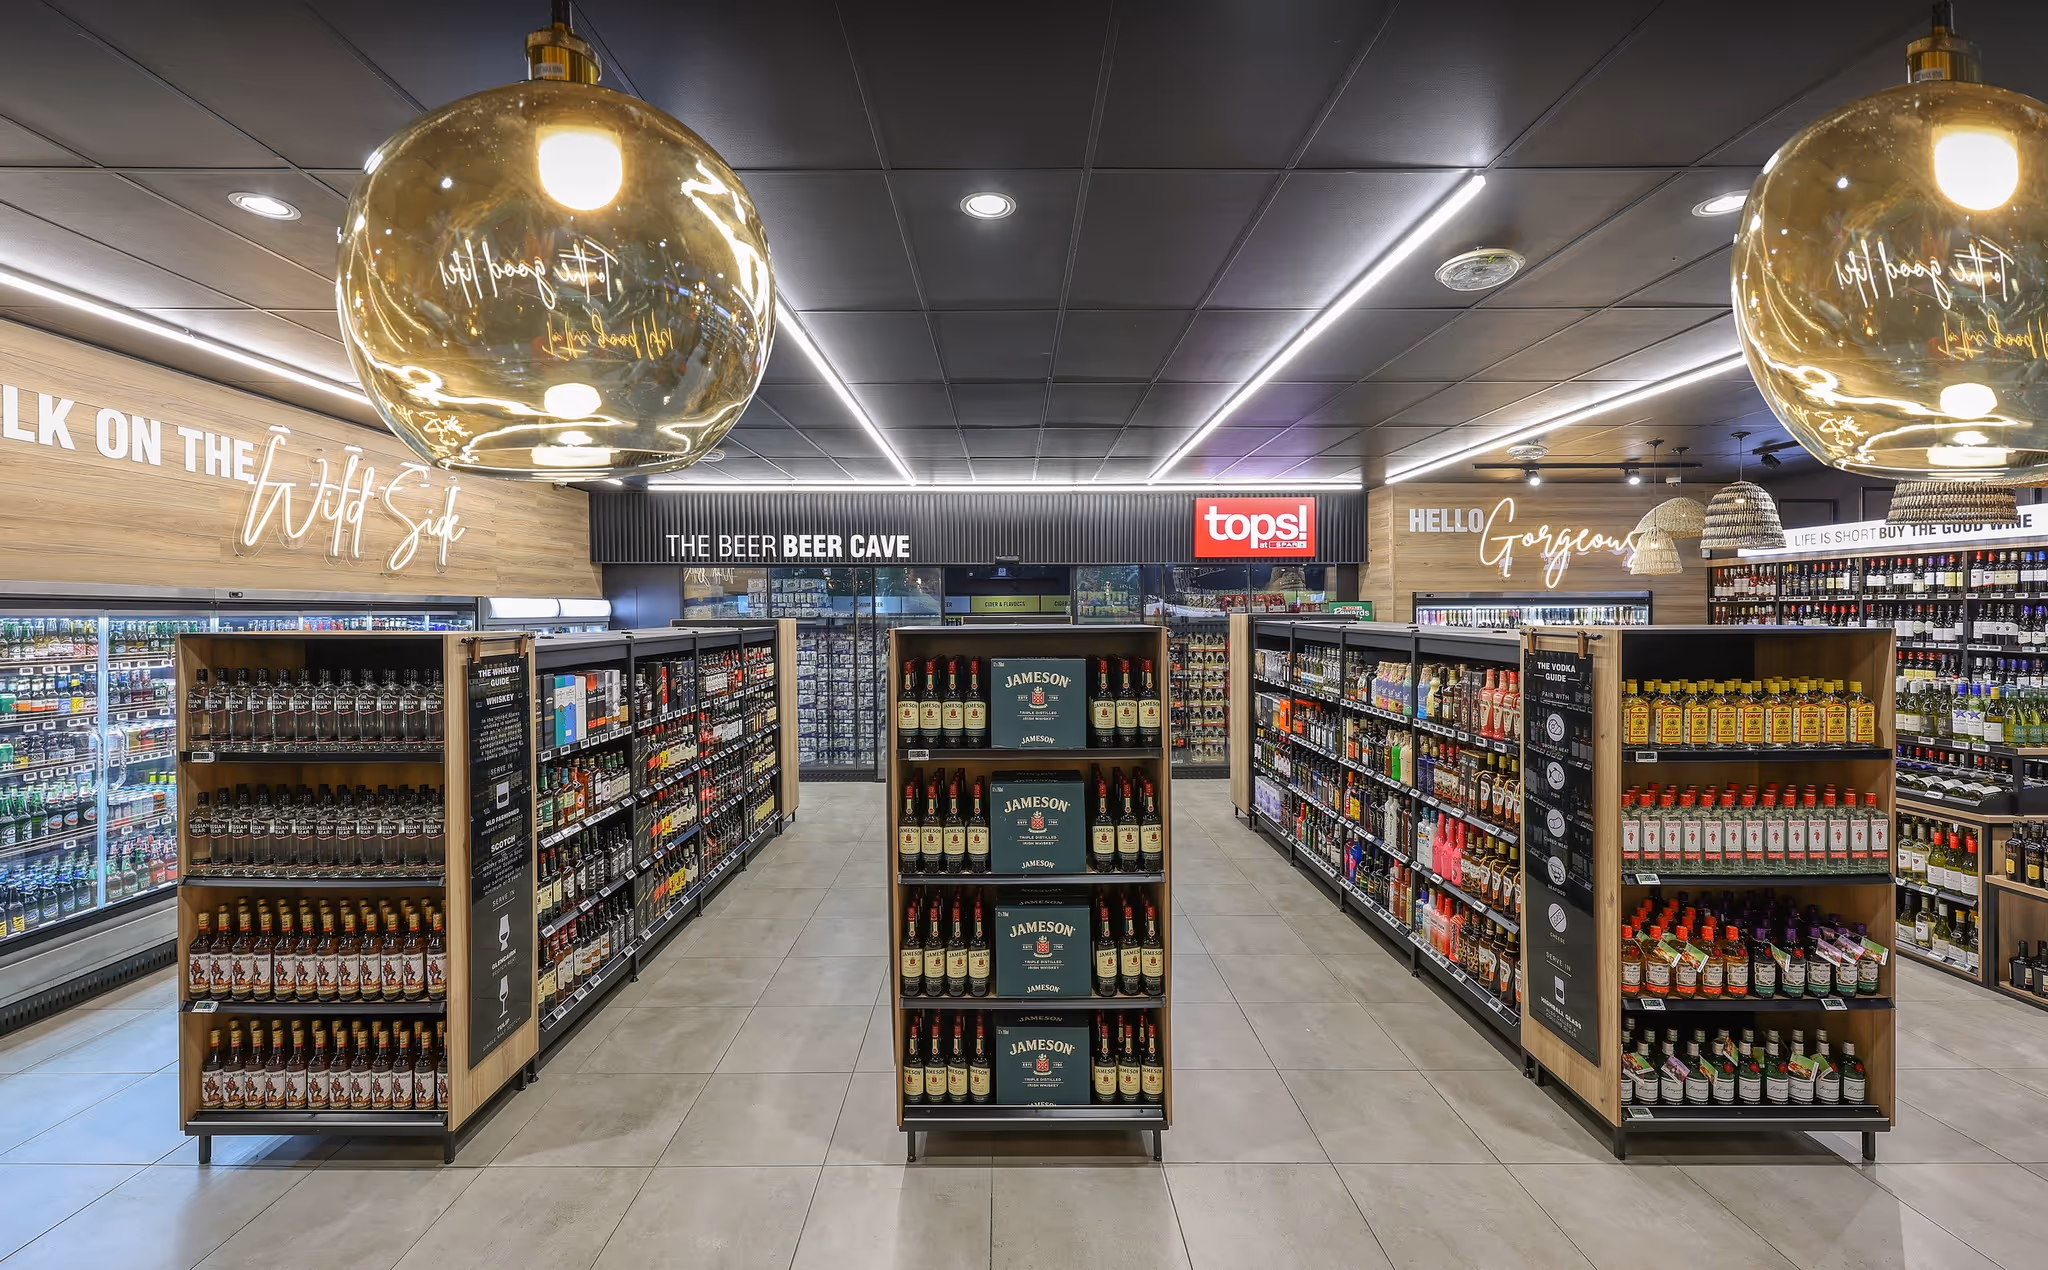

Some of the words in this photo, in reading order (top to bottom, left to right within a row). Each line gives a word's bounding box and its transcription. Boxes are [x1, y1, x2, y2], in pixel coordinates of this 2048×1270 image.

[2, 384, 76, 451] LK
[96, 408, 162, 466] ON
[177, 425, 255, 483] THE
[242, 430, 374, 558] Wild
[381, 466, 467, 571] Side
[1204, 505, 1307, 549] tops!
[1409, 508, 1484, 533] HELLO
[1794, 533, 1816, 547] LIFE
[1820, 532, 1831, 544] IS
[1835, 527, 1877, 543] SHORT
[1879, 525, 1905, 540] BUY
[1909, 523, 1937, 537] THE
[1941, 522, 1984, 534] GOOD
[665, 534, 710, 557] THE
[718, 534, 777, 557] BEER
[783, 534, 843, 558] BEER
[850, 534, 910, 558] CAVE
[1259, 541, 1268, 549] at
[478, 668, 492, 678] THE
[492, 665, 520, 676] WHISKEY
[1537, 662, 1551, 670] THE
[1551, 663, 1576, 673] VODKA
[490, 677, 510, 687] GUIDE
[1005, 671, 1069, 689] JAMESON
[1545, 672, 1567, 683] GUIDE
[486, 693, 514, 706] WHISKEY
[1541, 690, 1554, 698] PAIR
[1555, 693, 1570, 701] WITH
[1020, 735, 1056, 745] JAMESON
[490, 765, 506, 776] SERVE
[1004, 796, 1069, 814] JAMESON
[485, 818, 496, 827] OLD
[495, 808, 520, 822] FASHIONED
[490, 834, 516, 853] SCOTCH
[1021, 859, 1055, 870] JAMESON
[1547, 884, 1567, 897] SEAFOOD
[492, 892, 508, 907] SERVE
[1009, 920, 1073, 938] JAMESON
[1549, 931, 1566, 945] CHEESE
[491, 948, 517, 970] GLENCAIRN
[1546, 951, 1563, 967] SERVE
[1026, 983, 1061, 994] JAMESON
[1540, 996, 1565, 1018] HIGHBALL
[1565, 1012, 1582, 1030] GLASS
[496, 1018, 510, 1032] TULIP
[1009, 1039, 1073, 1056] JAMESON
